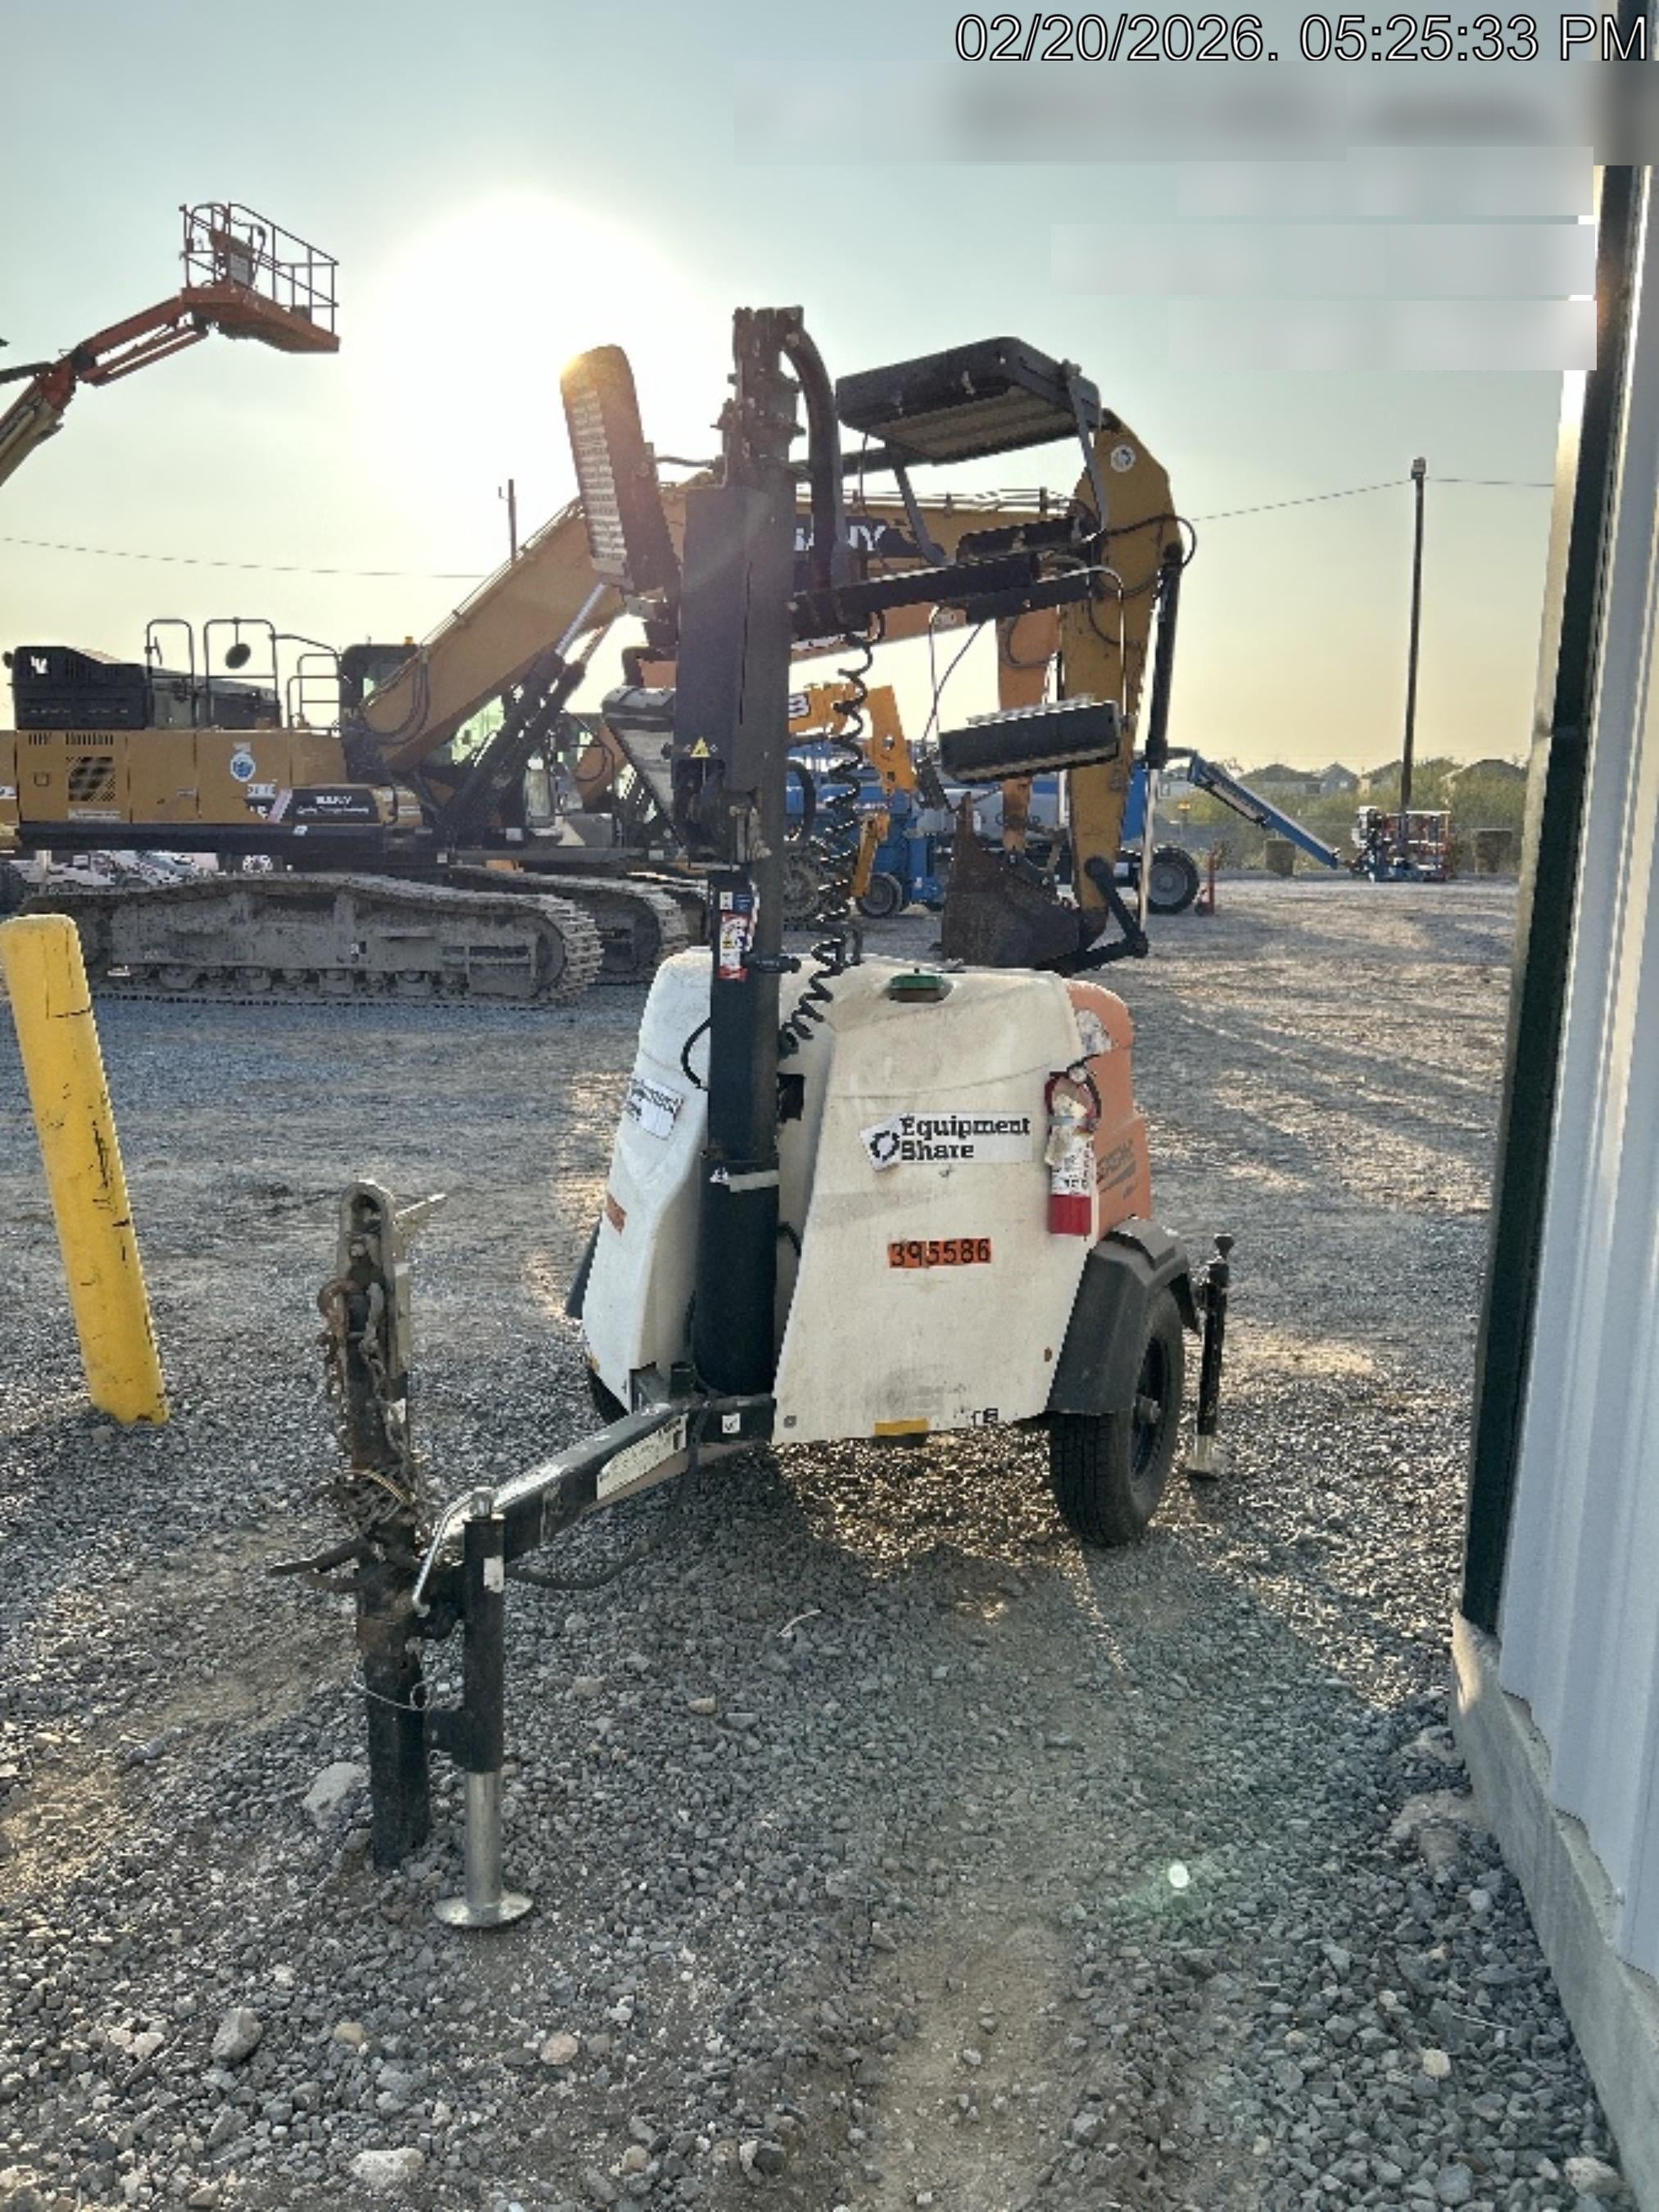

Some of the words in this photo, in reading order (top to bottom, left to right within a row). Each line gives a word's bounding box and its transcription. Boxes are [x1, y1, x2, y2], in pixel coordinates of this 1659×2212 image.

[900, 1115, 1031, 1140] Equipment
[902, 1140, 974, 1160] Share
[891, 1238, 990, 1267] 395586
